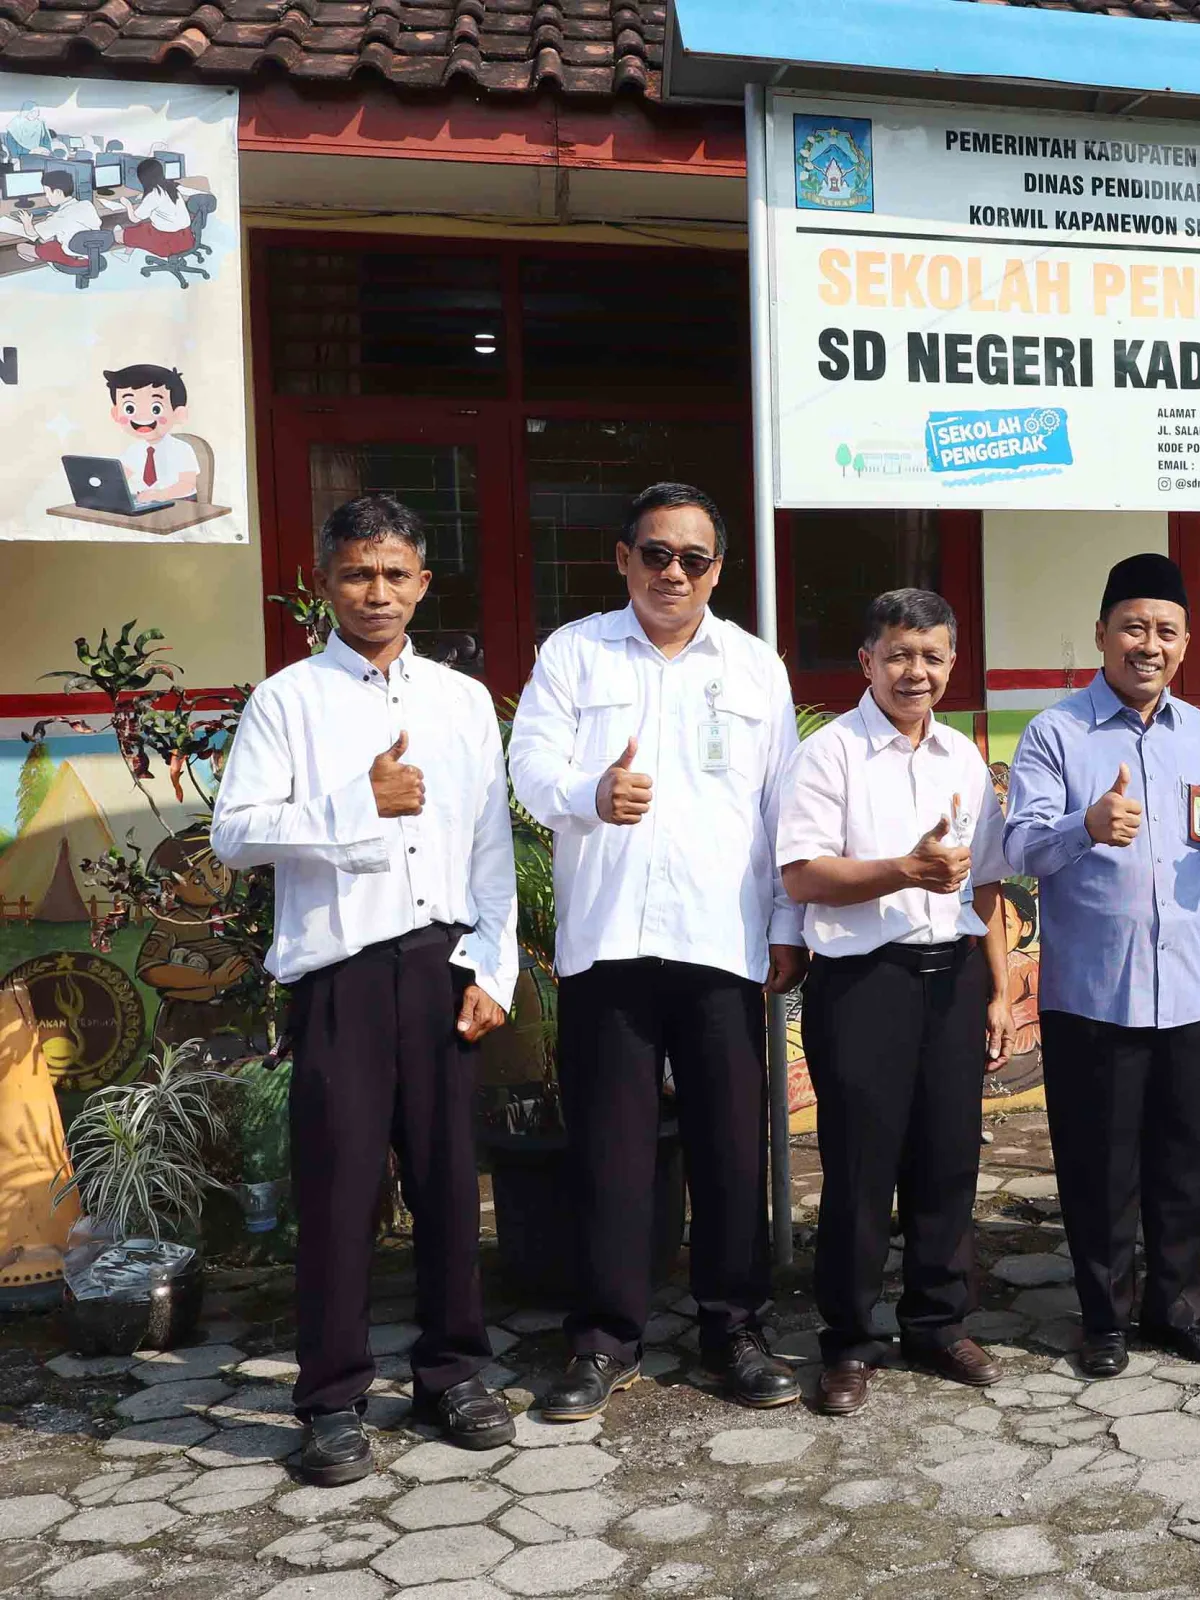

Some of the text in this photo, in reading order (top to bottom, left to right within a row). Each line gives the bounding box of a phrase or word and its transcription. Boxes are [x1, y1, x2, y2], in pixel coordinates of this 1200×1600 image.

[945, 129, 1077, 160] PEMERINTAH
[1084, 140, 1197, 168] KABUPATEN
[1024, 172, 1084, 196] DINAS
[969, 204, 1049, 230] KORWIL
[1055, 210, 1178, 236] KAPANEWON
[818, 248, 1071, 316] SEKOLAH
[817, 327, 887, 382] SD
[907, 331, 1094, 388] NEGERI
[1157, 408, 1197, 419] ALAMAT
[937, 416, 1022, 446] SEKOLAH
[1157, 425, 1172, 436] JL.
[941, 435, 1047, 467] PENGGERAK
[1157, 442, 1184, 454] KODE
[1158, 460, 1189, 471] EMAIL
